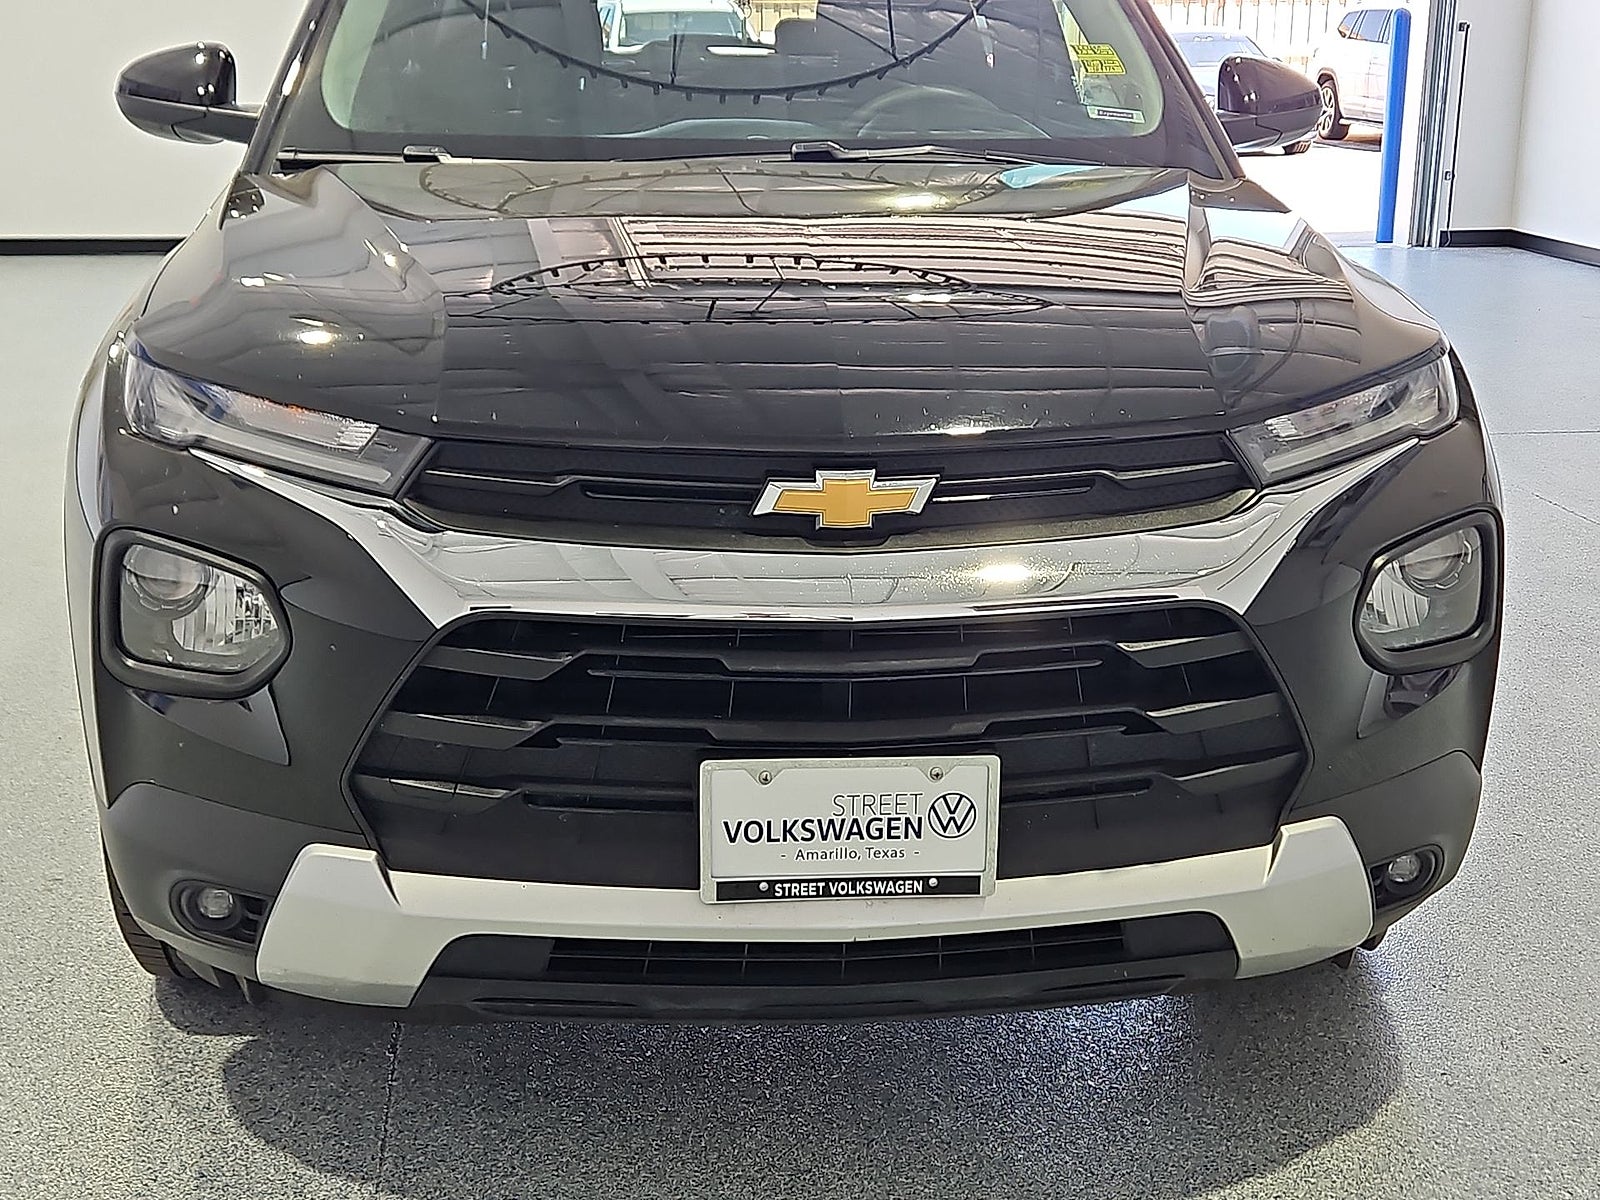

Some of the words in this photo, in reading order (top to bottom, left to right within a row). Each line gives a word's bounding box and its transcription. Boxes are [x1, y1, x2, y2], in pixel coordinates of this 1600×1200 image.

[832, 793, 923, 816] STREET
[722, 816, 923, 844] VOLKSWAGEN
[795, 847, 862, 861] Amarillo,
[865, 847, 905, 859] Texas
[774, 884, 825, 897] STREET
[829, 881, 923, 895] VOLKSWAGEN
